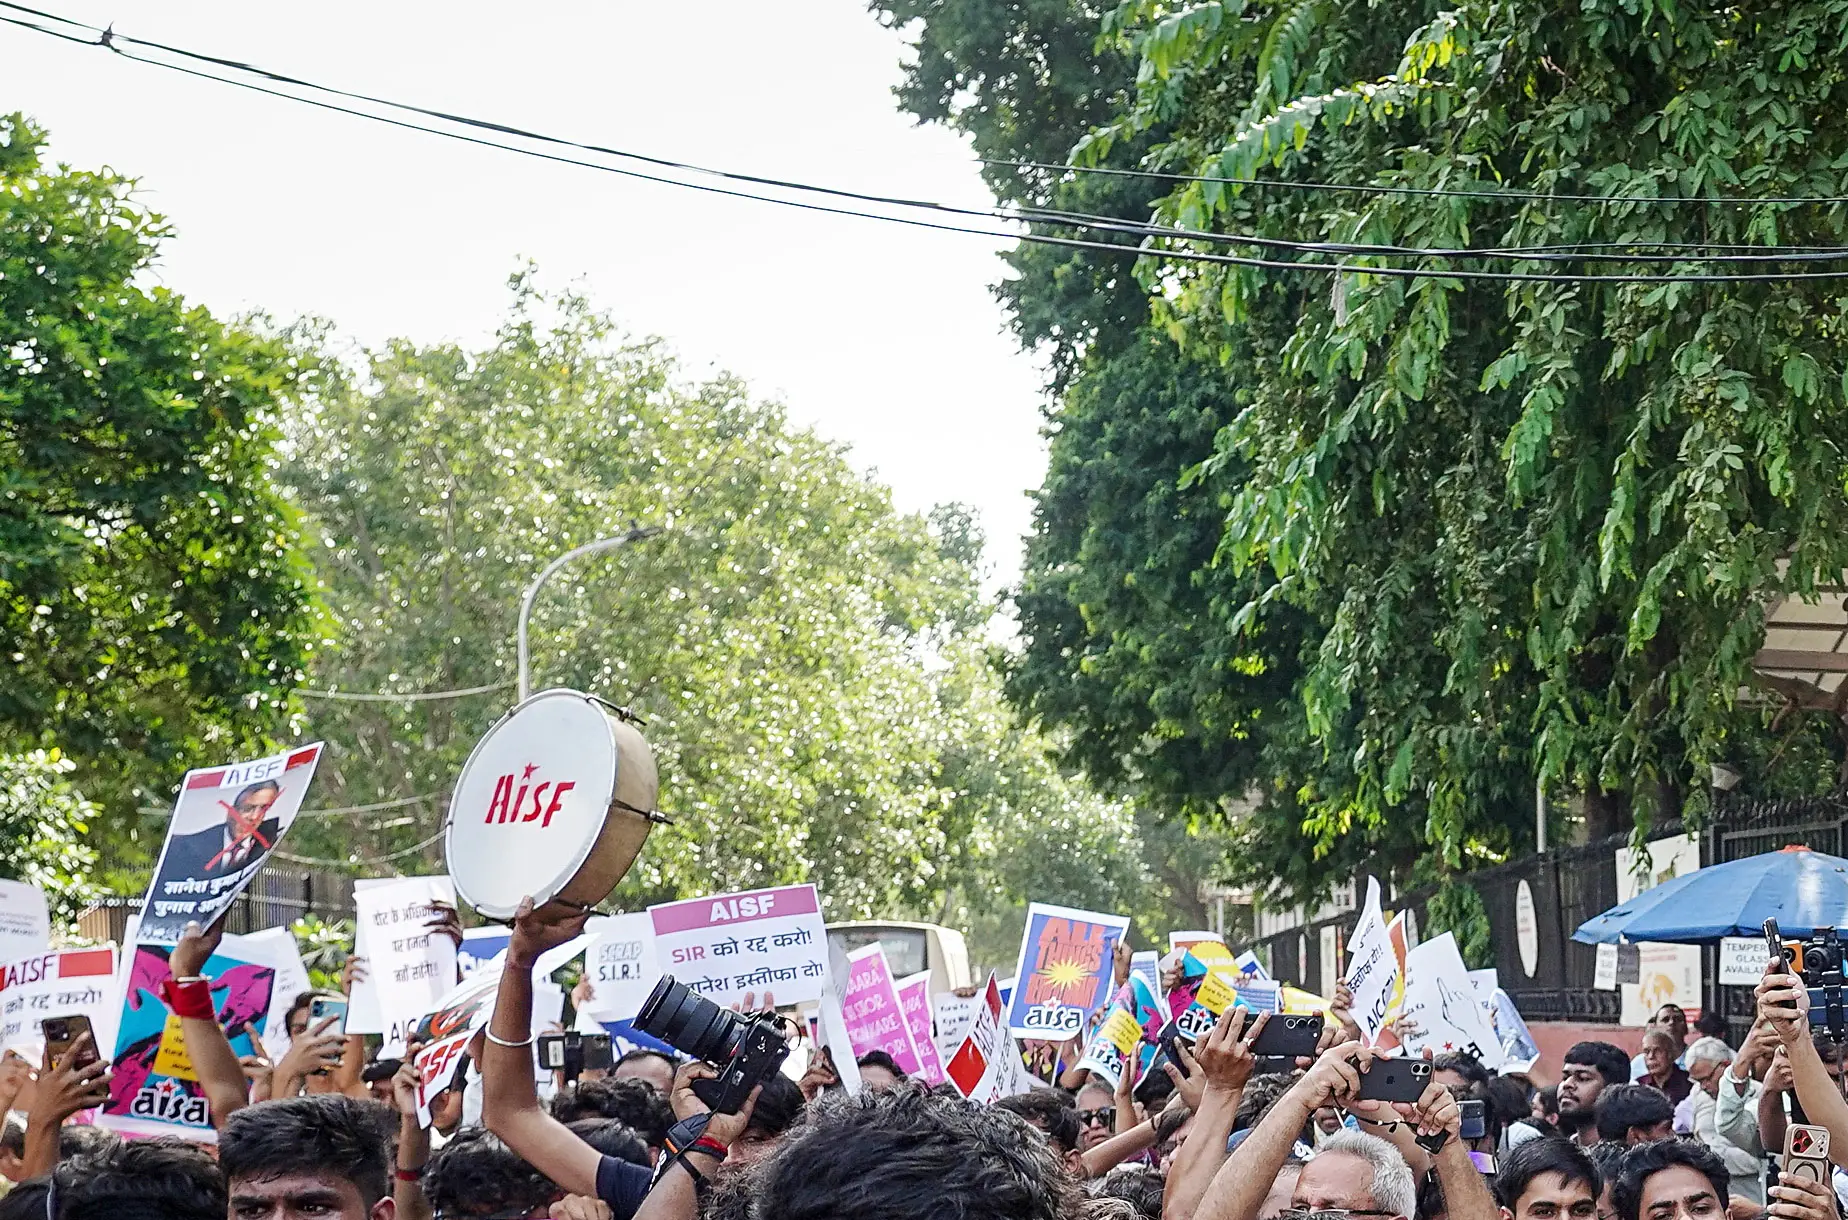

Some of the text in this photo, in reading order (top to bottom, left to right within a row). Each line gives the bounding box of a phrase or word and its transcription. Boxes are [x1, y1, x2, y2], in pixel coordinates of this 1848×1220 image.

[227, 758, 283, 785] AISF
[707, 894, 775, 923] AISF
[672, 926, 813, 964] SIR को रद्द करो!
[1039, 916, 1107, 947] ALL
[1726, 943, 1767, 952] TEMPER
[6, 954, 56, 988] AISF
[736, 967, 797, 991] इस्तीफा
[800, 959, 825, 978] दो!
[1025, 1003, 1082, 1030] aisa
